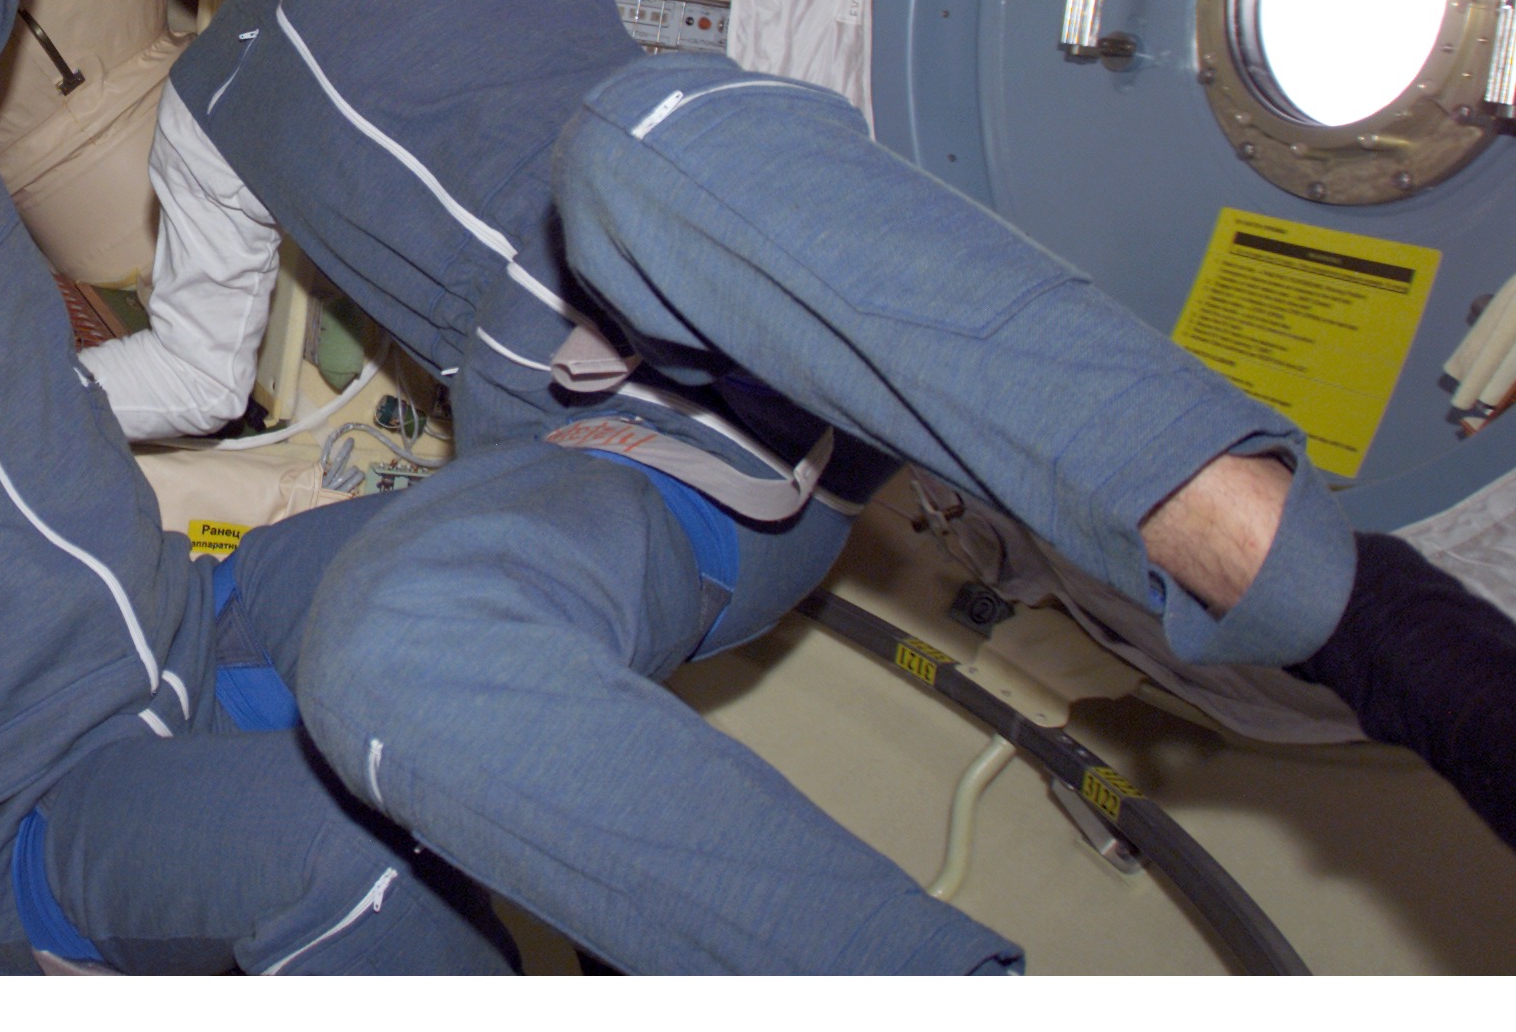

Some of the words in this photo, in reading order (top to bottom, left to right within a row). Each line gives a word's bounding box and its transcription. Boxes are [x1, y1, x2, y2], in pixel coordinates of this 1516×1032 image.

[201, 524, 241, 539] Ранец
[899, 646, 936, 682] 3121
[1084, 774, 1119, 818] 3122
